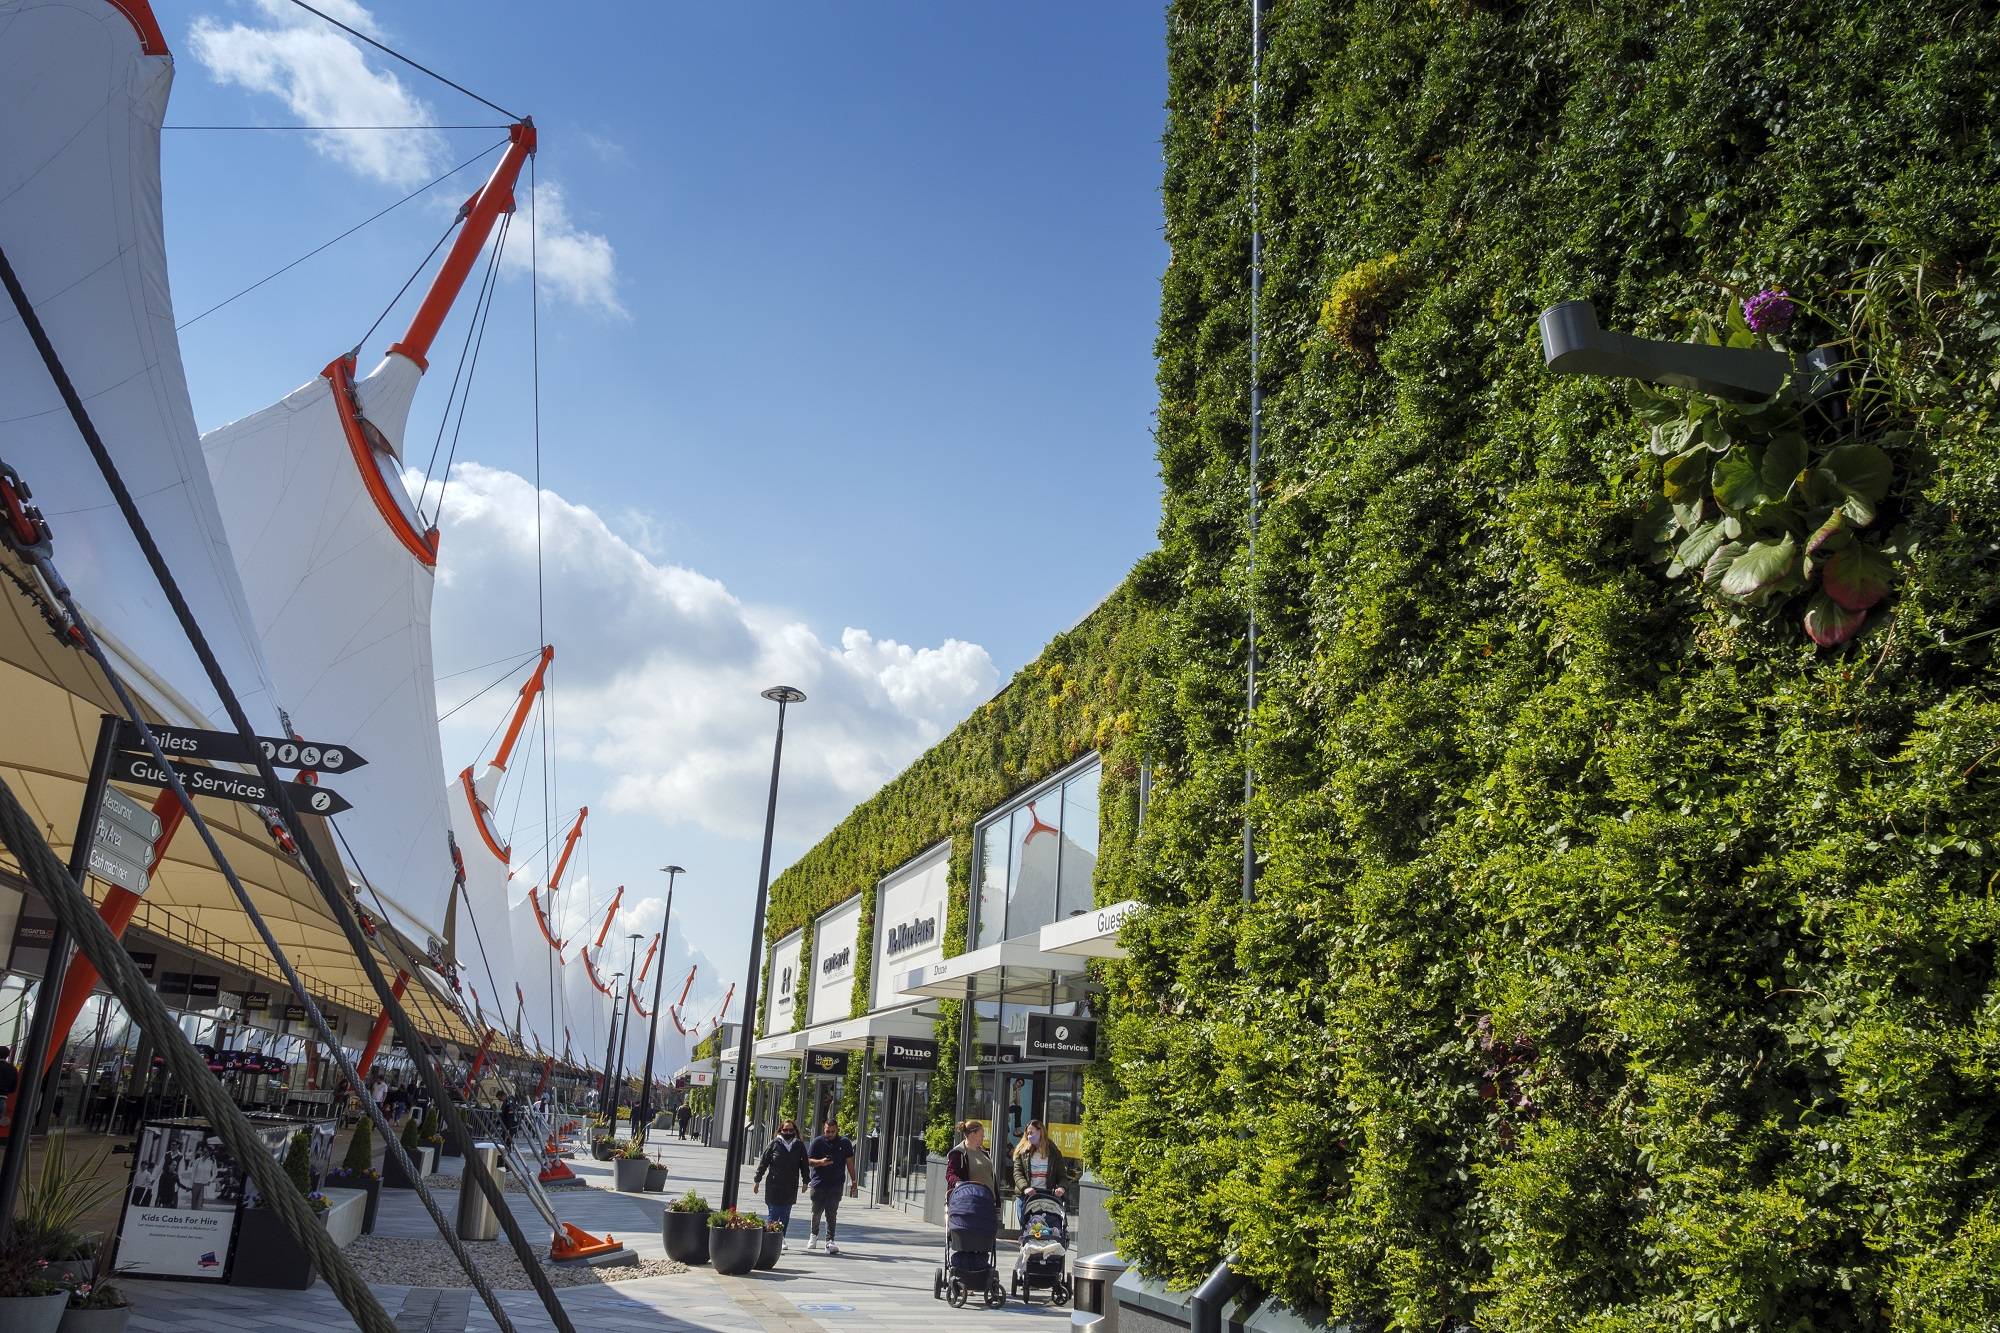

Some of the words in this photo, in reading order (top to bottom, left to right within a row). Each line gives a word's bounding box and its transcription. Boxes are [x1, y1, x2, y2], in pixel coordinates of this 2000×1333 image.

[131, 761, 187, 785] Guet
[192, 772, 265, 799] Services
[108, 826, 121, 847] Area
[90, 850, 104, 870] Cash
[103, 857, 128, 880] machines
[893, 1046, 932, 1058] Dune
[1034, 1041, 1056, 1050] Guest
[1057, 1043, 1089, 1052] Services
[141, 1214, 160, 1222] Kids
[161, 1215, 183, 1224] Cabs
[186, 1216, 199, 1224] For
[200, 1217, 218, 1226] Hire
